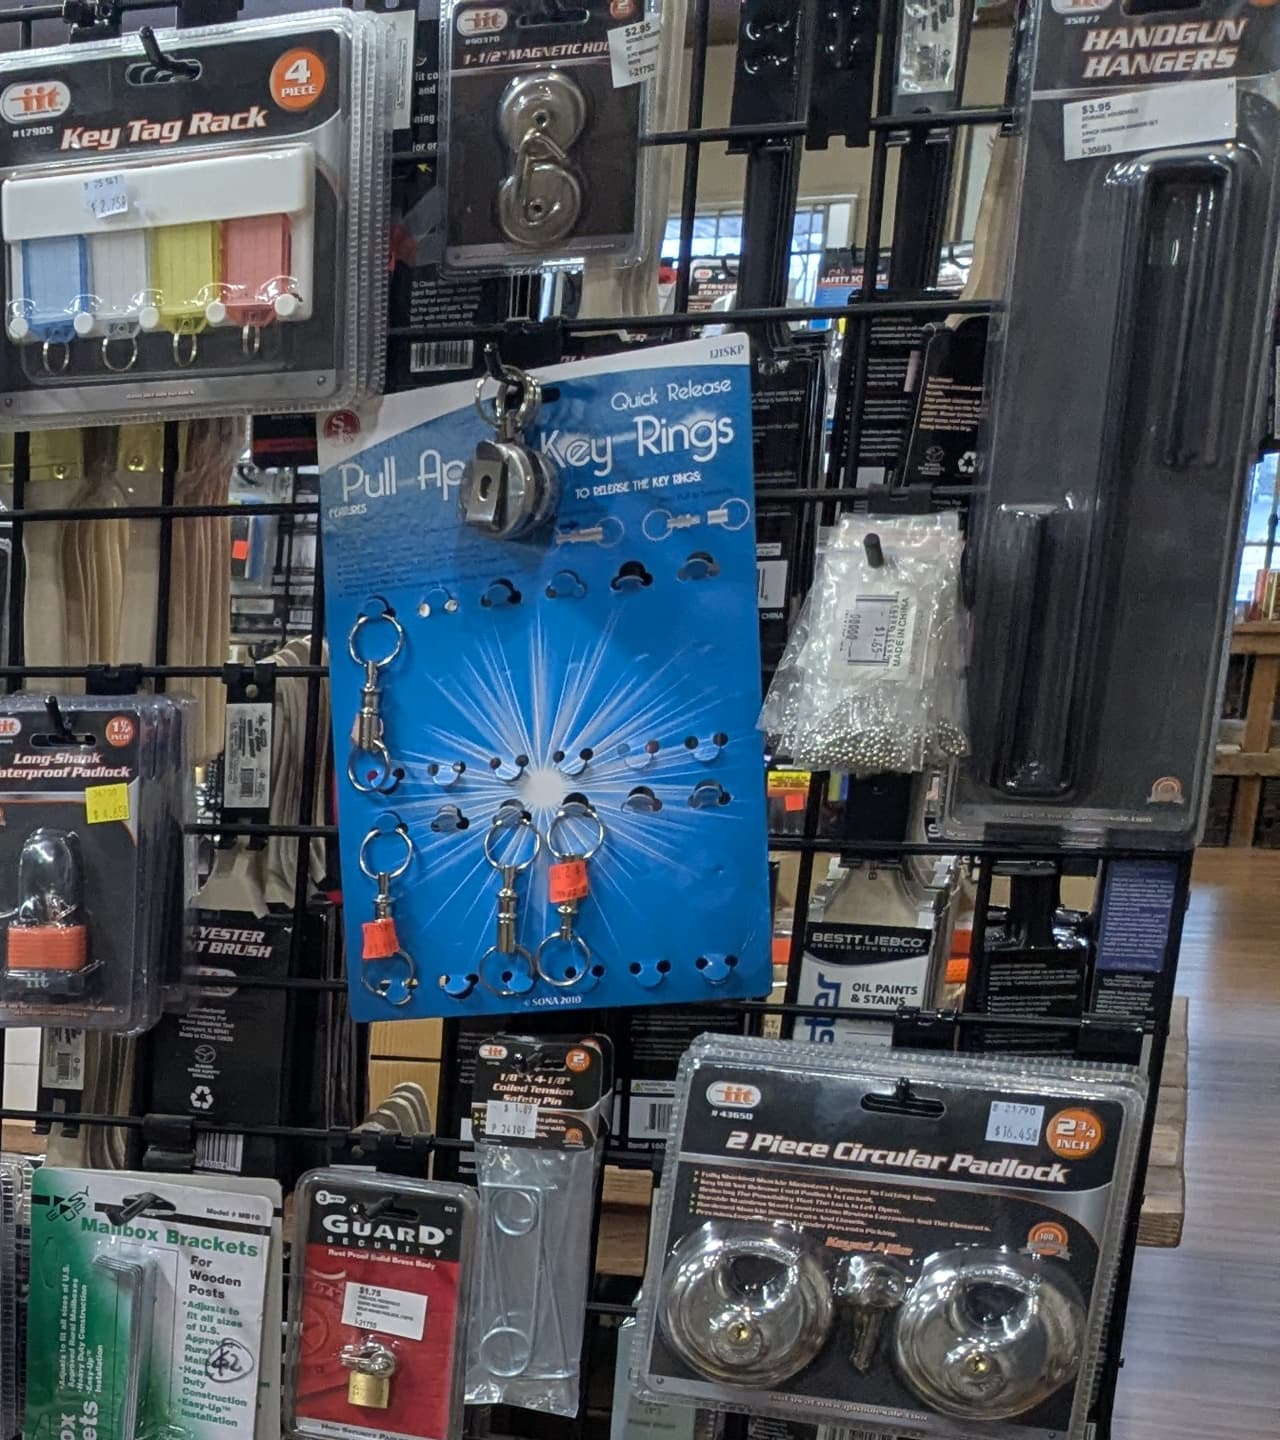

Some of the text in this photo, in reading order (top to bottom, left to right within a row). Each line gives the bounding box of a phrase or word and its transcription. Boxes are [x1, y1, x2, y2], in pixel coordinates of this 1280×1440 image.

[625, 22, 651, 37] $2.95
[1082, 18, 1248, 52] HANDGUN
[462, 42, 581, 65] 1-1/2" MAGNETIC
[1082, 48, 1238, 78] HANGERS
[284, 59, 310, 85] 4
[281, 85, 317, 98] PIECE
[1081, 102, 1111, 114] $3.95
[13, 125, 54, 139] #17905
[60, 107, 267, 150] Key Tag Rack
[611, 376, 732, 411] Quick Release
[540, 414, 734, 477] Key Rings
[338, 462, 396, 500] Pull
[634, 475, 669, 491] THE KEY
[893, 597, 910, 667] MADE CHINA
[13, 753, 103, 765] Long-Shank
[76, 766, 131, 778] Padlock
[811, 932, 925, 948] BESTT LIEBCO
[209, 941, 273, 958] BRUSH
[852, 983, 918, 995] OIL PAINTS
[531, 994, 581, 1007] SONA 2010
[862, 994, 906, 1006] STAINS
[492, 1083, 574, 1096] Coiled Tension
[503, 1094, 562, 1106] Safety Pin
[1057, 1139, 1090, 1151] INCH
[725, 1131, 1070, 1184] 2 Piece Circular Padlock
[206, 1207, 229, 1216] Model
[81, 1218, 258, 1257] Mailbox Brackets
[322, 1214, 446, 1245] GUARD
[327, 1236, 442, 1257] SECURITY
[190, 1255, 212, 1268] For
[190, 1269, 241, 1287] Wooden
[189, 1285, 225, 1299] Posts
[183, 1377, 206, 1389] Duty
[182, 1388, 247, 1406] Construction
[181, 1409, 238, 1426] Installation
